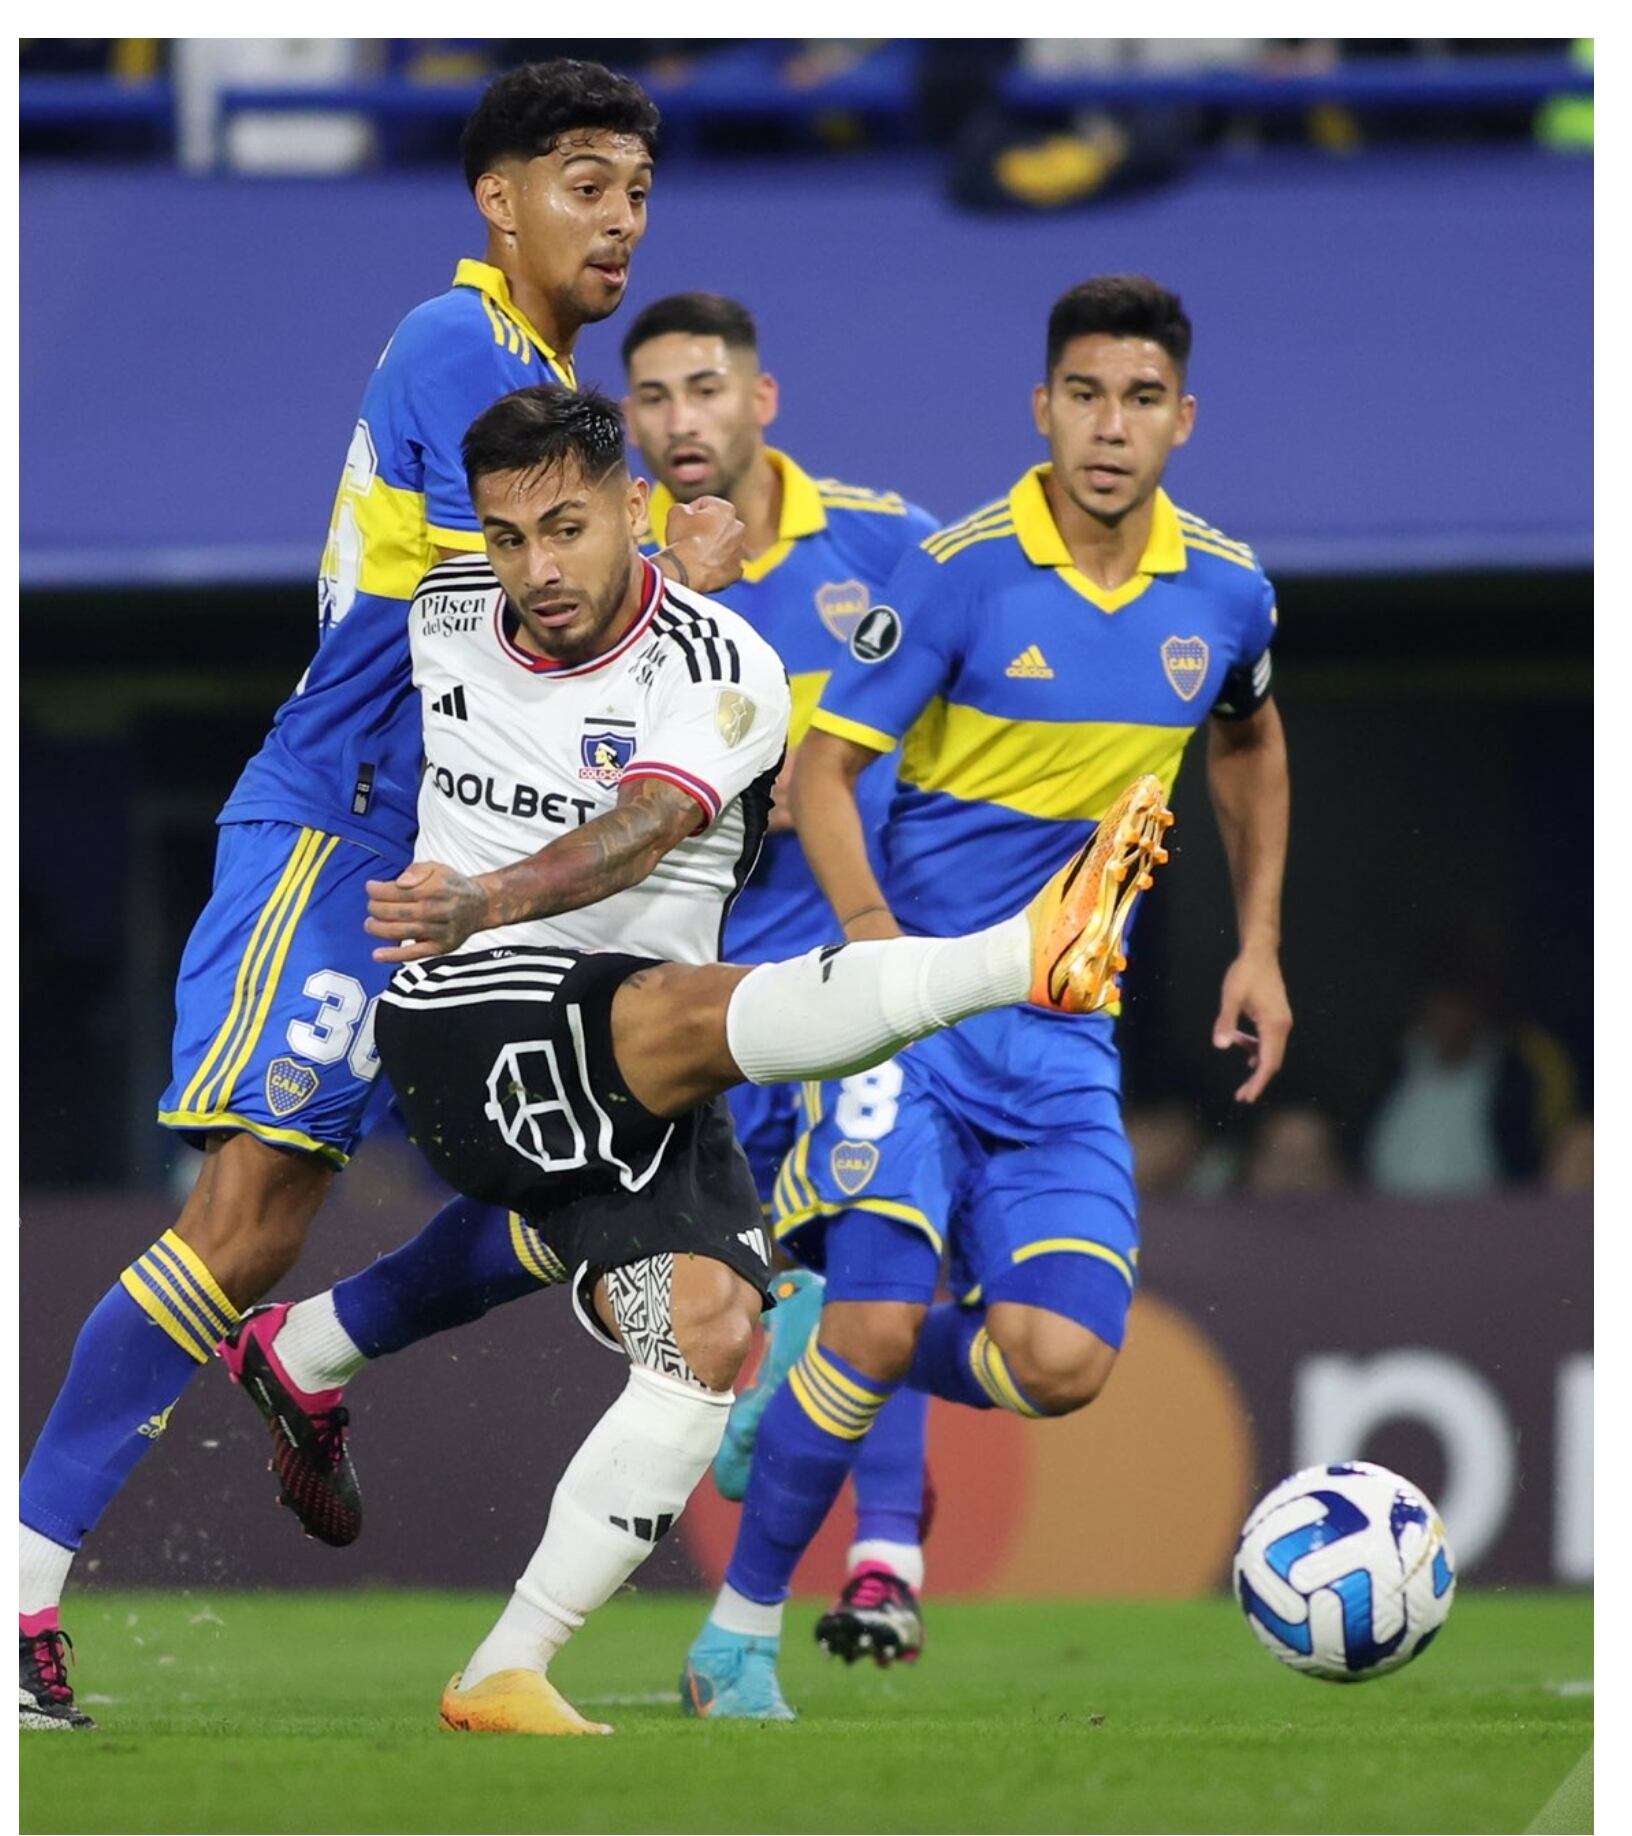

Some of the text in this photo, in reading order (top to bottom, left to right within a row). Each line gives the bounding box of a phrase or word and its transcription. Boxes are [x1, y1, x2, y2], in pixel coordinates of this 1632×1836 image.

[421, 595, 486, 619] Pilsen
[442, 615, 483, 638] Sur
[578, 768, 624, 780] COLO-CO
[426, 761, 596, 826] OOLBET
[271, 1075, 307, 1098] CABJ
[835, 1060, 904, 1140] 8
